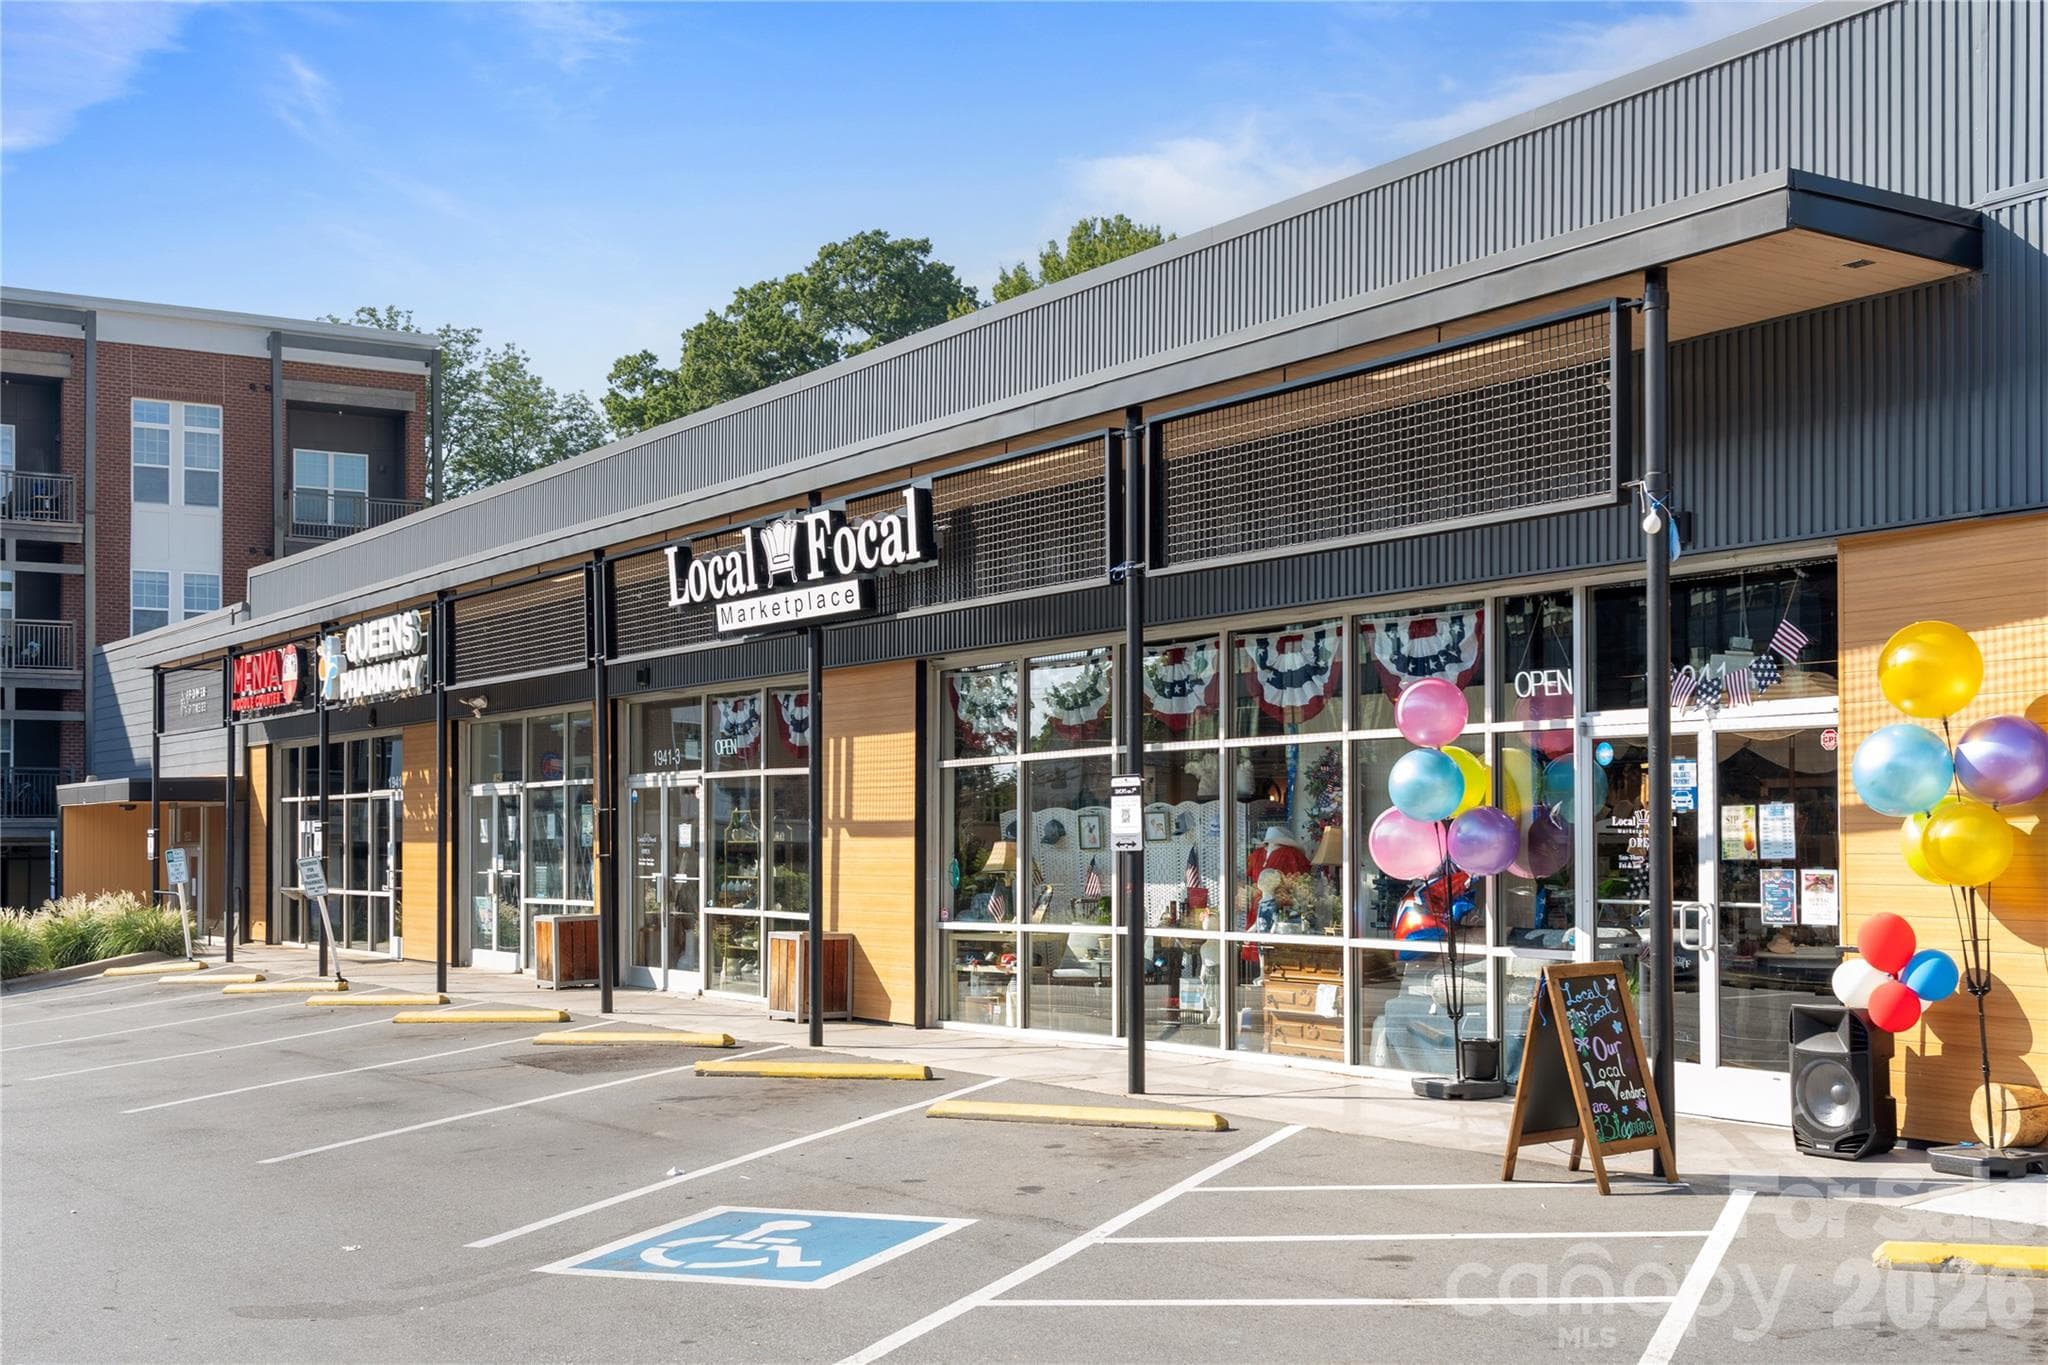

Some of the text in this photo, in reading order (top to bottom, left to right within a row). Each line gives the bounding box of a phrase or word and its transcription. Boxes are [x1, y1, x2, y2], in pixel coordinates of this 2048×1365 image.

[664, 487, 921, 606] Local Focal
[720, 586, 856, 626] Marketplace
[345, 611, 419, 663] QUEENS
[233, 651, 282, 694] MENYA
[340, 656, 420, 700] PHARMACY
[1514, 668, 1573, 698] OPEN
[653, 748, 681, 766] 1941-3
[715, 739, 737, 755] OPEN
[1612, 816, 1636, 827] Local
[1629, 837, 1650, 848] OPE
[1560, 980, 1609, 1006] Local
[1584, 998, 1619, 1027] Focal
[1592, 1036, 1623, 1061] Our
[1582, 1052, 1626, 1090] Local
[1606, 1079, 1647, 1101] Vendors
[1592, 1102, 1612, 1114] are
